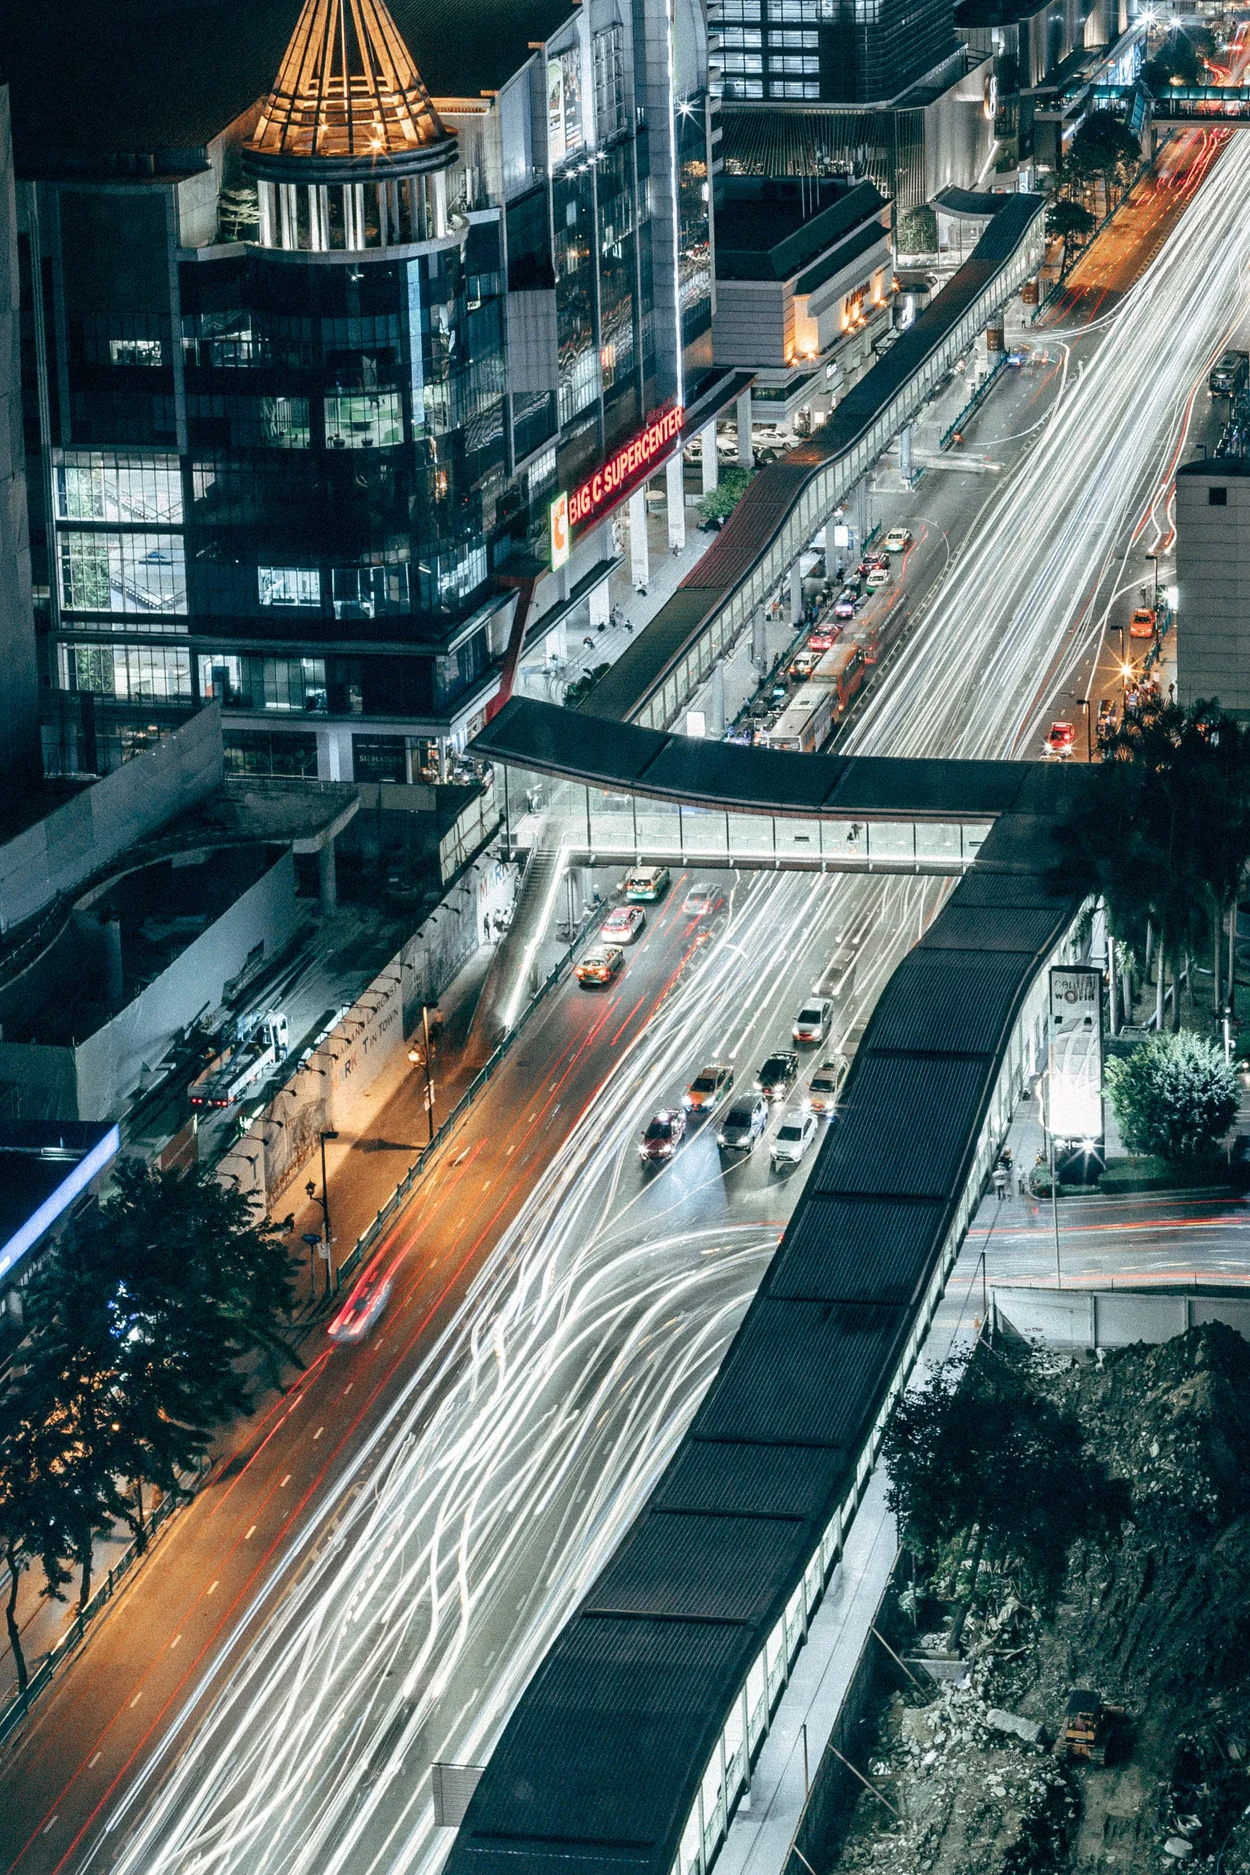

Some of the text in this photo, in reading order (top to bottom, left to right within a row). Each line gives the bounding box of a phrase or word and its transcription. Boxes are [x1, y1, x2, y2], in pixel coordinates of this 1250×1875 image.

[569, 406, 683, 526] BIG C SUPERCENTER
